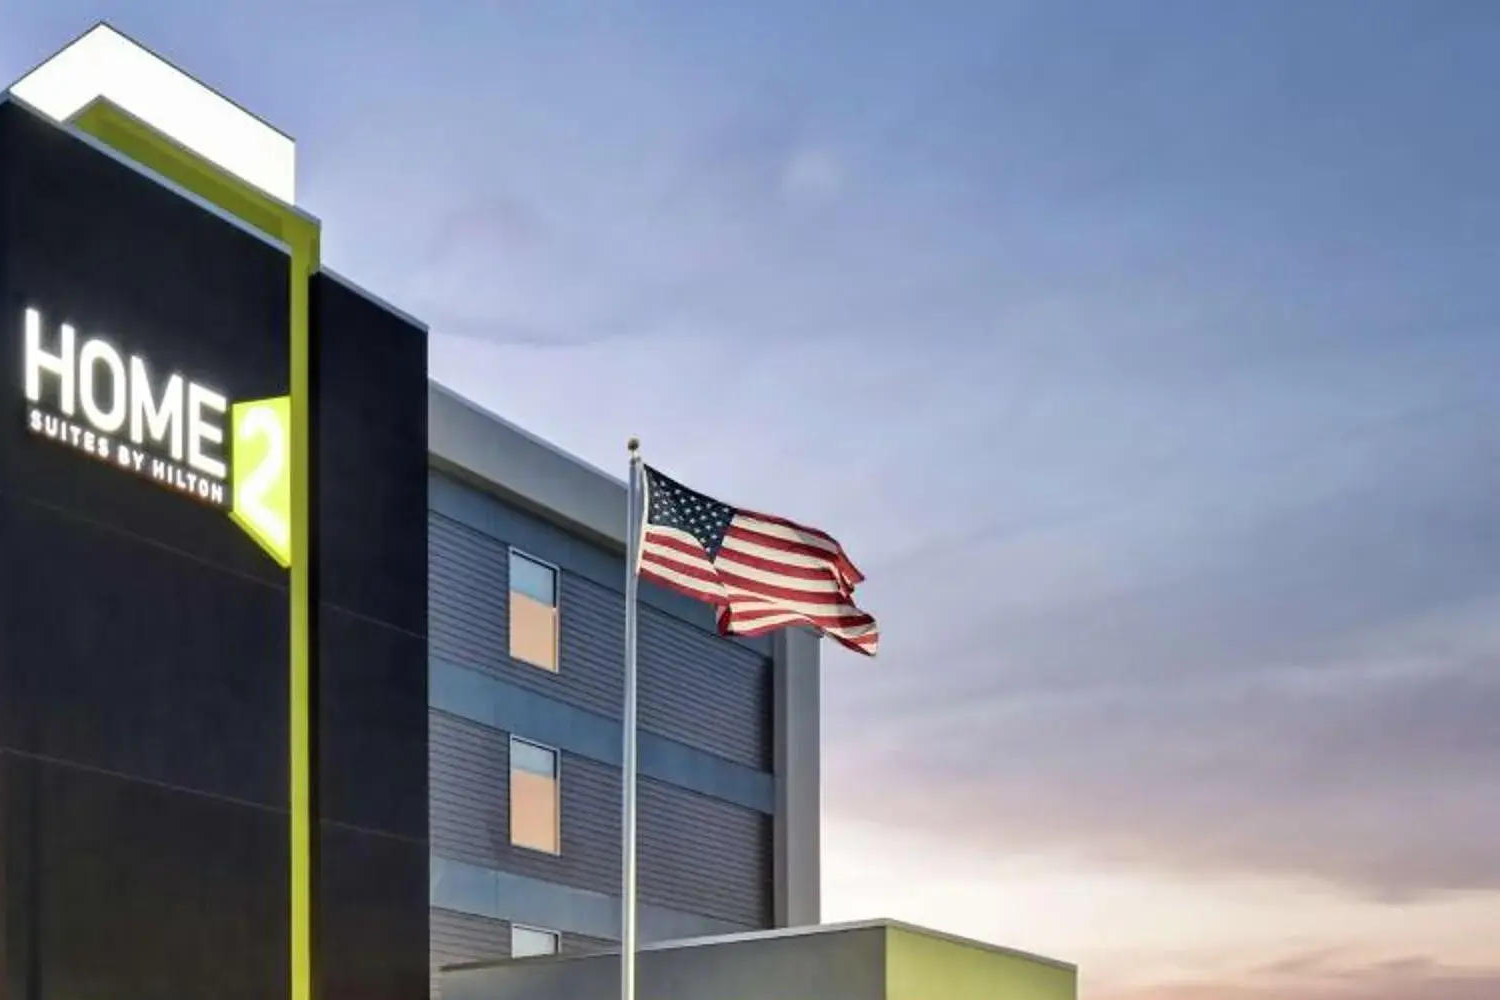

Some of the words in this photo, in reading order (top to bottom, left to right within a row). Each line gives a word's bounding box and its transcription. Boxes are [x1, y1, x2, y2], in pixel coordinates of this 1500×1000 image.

[25, 307, 227, 479] HOME
[238, 406, 288, 550] 2
[30, 409, 109, 459] SUITES
[117, 445, 144, 471] BY
[152, 459, 223, 504] HILTON
